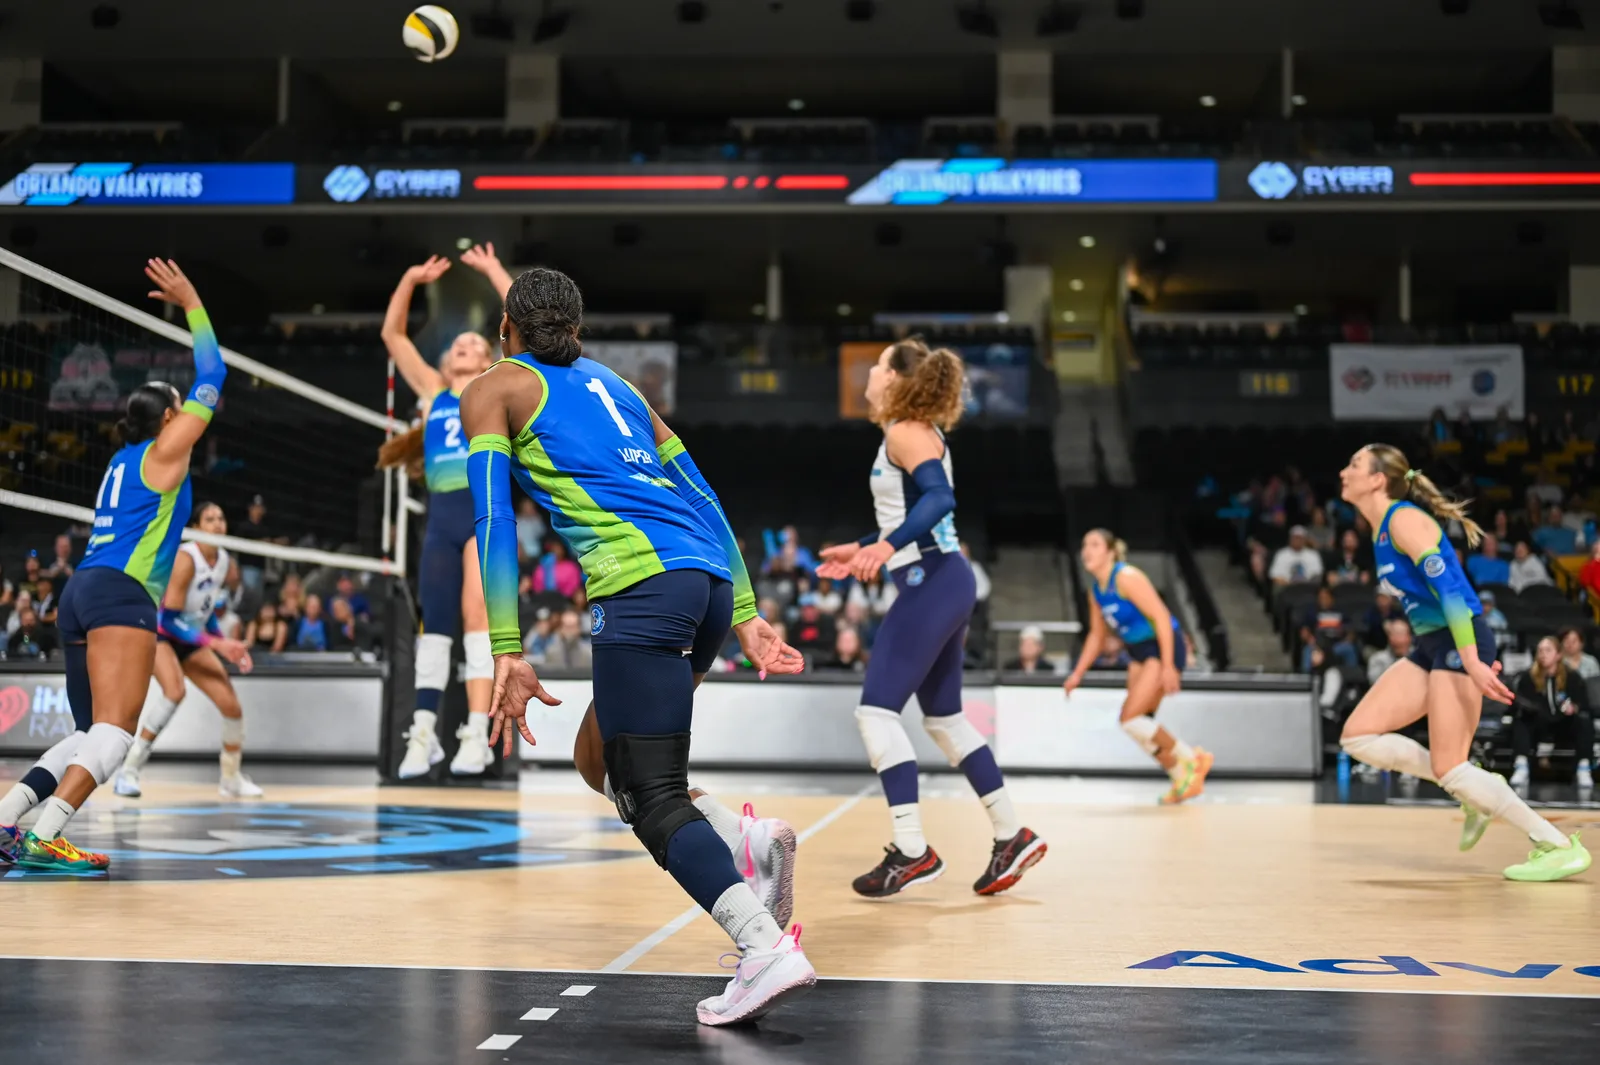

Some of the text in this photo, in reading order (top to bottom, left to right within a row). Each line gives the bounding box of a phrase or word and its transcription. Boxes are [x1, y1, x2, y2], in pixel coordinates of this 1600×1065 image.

[14, 172, 203, 198] ORLANDO VALKYRIES
[585, 378, 633, 437] 1
[444, 416, 462, 448] 2
[95, 463, 126, 508] 11
